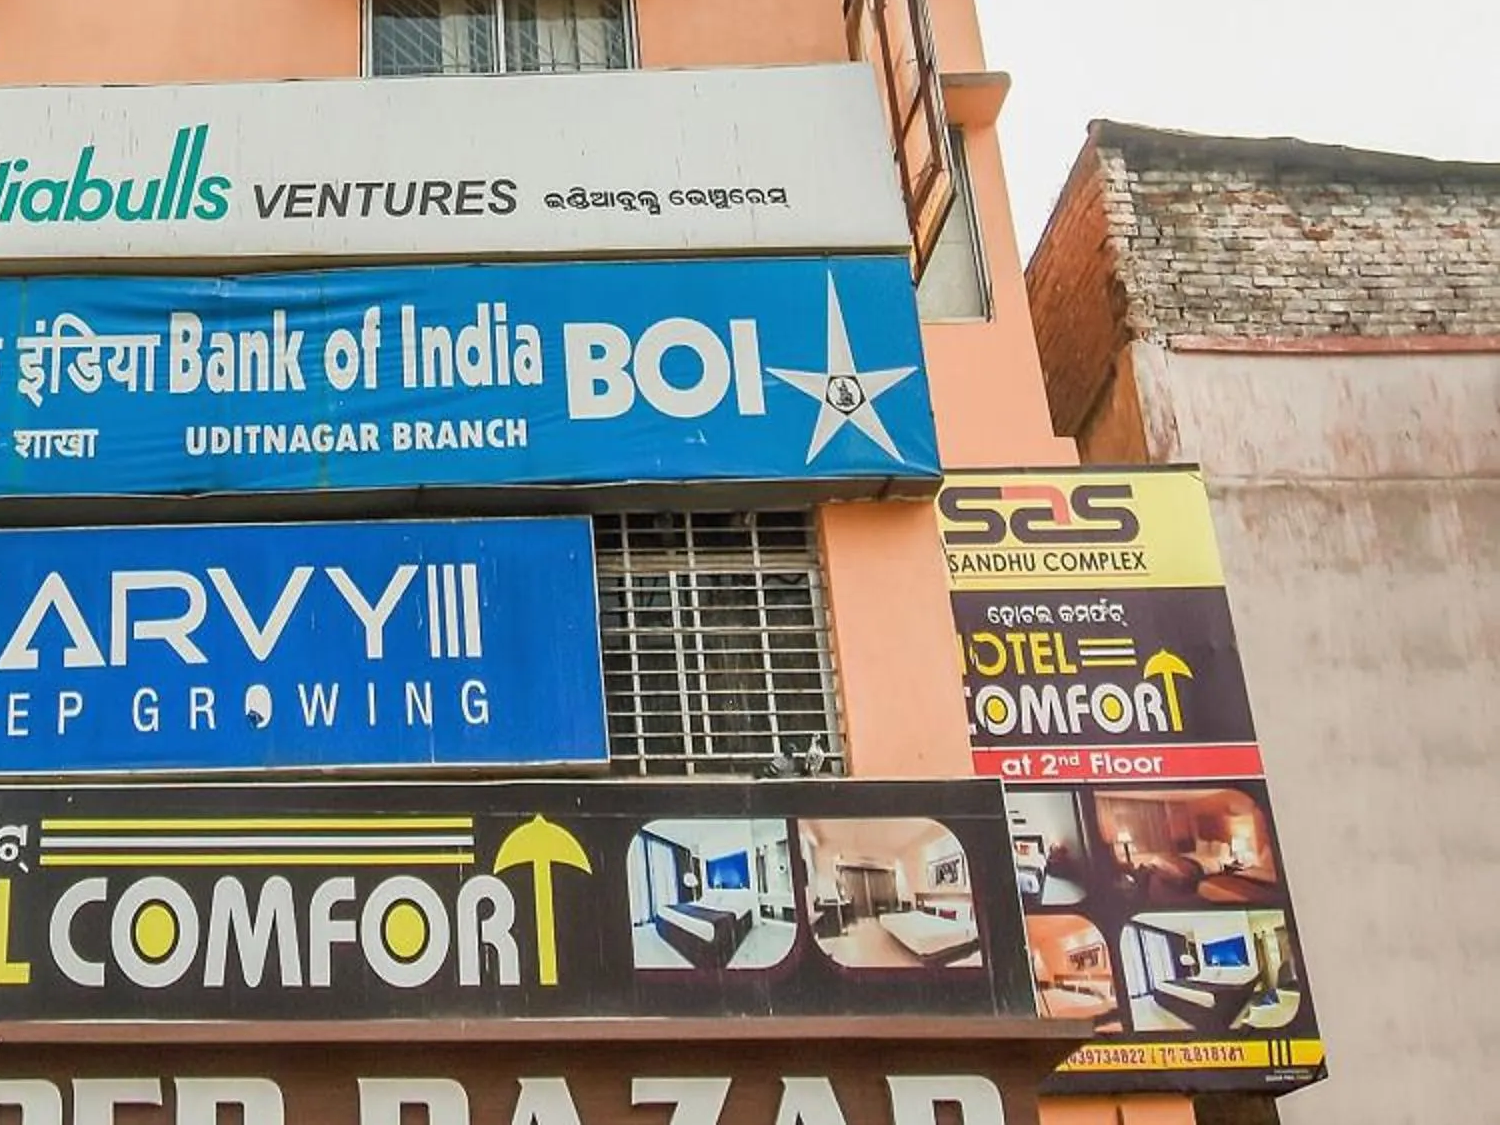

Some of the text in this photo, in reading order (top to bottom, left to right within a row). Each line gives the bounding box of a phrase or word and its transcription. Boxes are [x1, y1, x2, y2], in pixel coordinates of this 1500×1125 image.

[252, 179, 517, 219] VENTURES
[16, 313, 161, 407] इंडिया
[168, 302, 543, 394] Bank of India
[562, 317, 767, 420] BOI
[13, 429, 99, 459] शाखा
[185, 417, 529, 456] UDITNAGAR BRANCH
[948, 551, 1148, 573] SANDHU COMPLEX
[958, 632, 1078, 676] OTEL
[132, 679, 490, 732] GROWING
[964, 649, 1194, 736] OMFORT
[1002, 751, 1164, 776] at 2nd Floor
